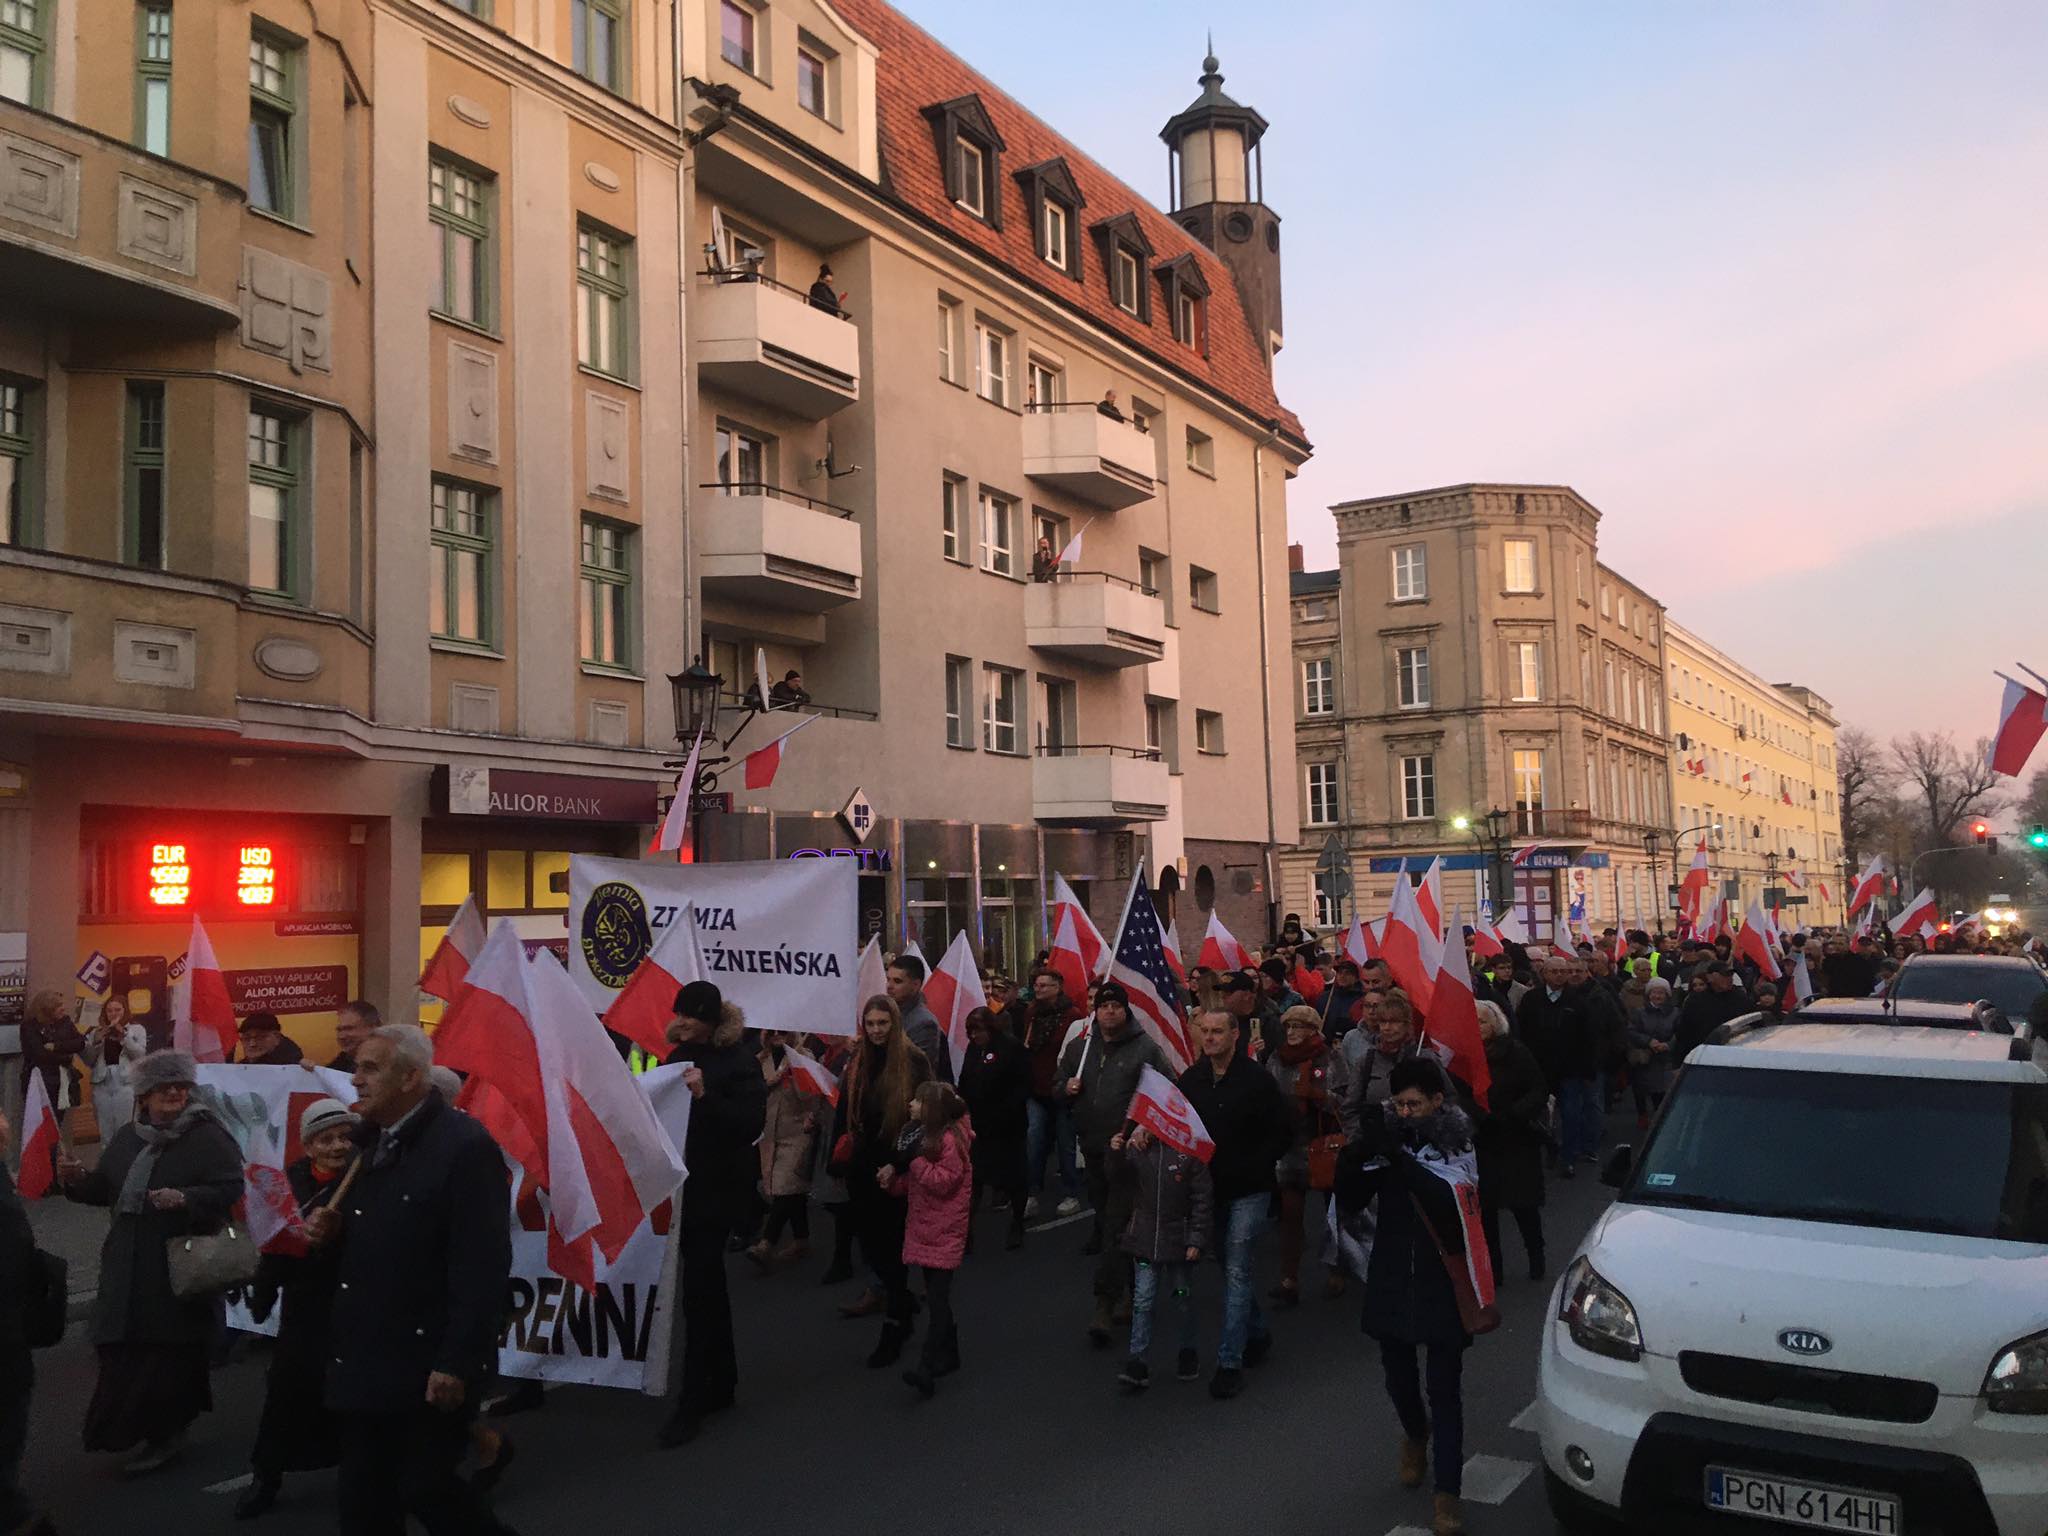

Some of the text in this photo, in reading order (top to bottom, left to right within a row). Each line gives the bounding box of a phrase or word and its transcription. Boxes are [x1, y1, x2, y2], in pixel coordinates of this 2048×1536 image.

[490, 792, 600, 815] ALIOR BANK
[153, 845, 185, 863] EUR
[240, 848, 271, 865] USD
[651, 905, 736, 931] ZIMIA
[284, 923, 352, 932] APLIKACJA MOBILNA
[237, 972, 332, 986] KONTO W APLIKACJI
[245, 985, 315, 998] ALIOR MOBILE
[231, 995, 337, 1012] PROSTA CODZIENNOŚĆ
[1787, 1333, 1822, 1350] KIA
[1725, 1476, 1895, 1534] PGN 614HH
